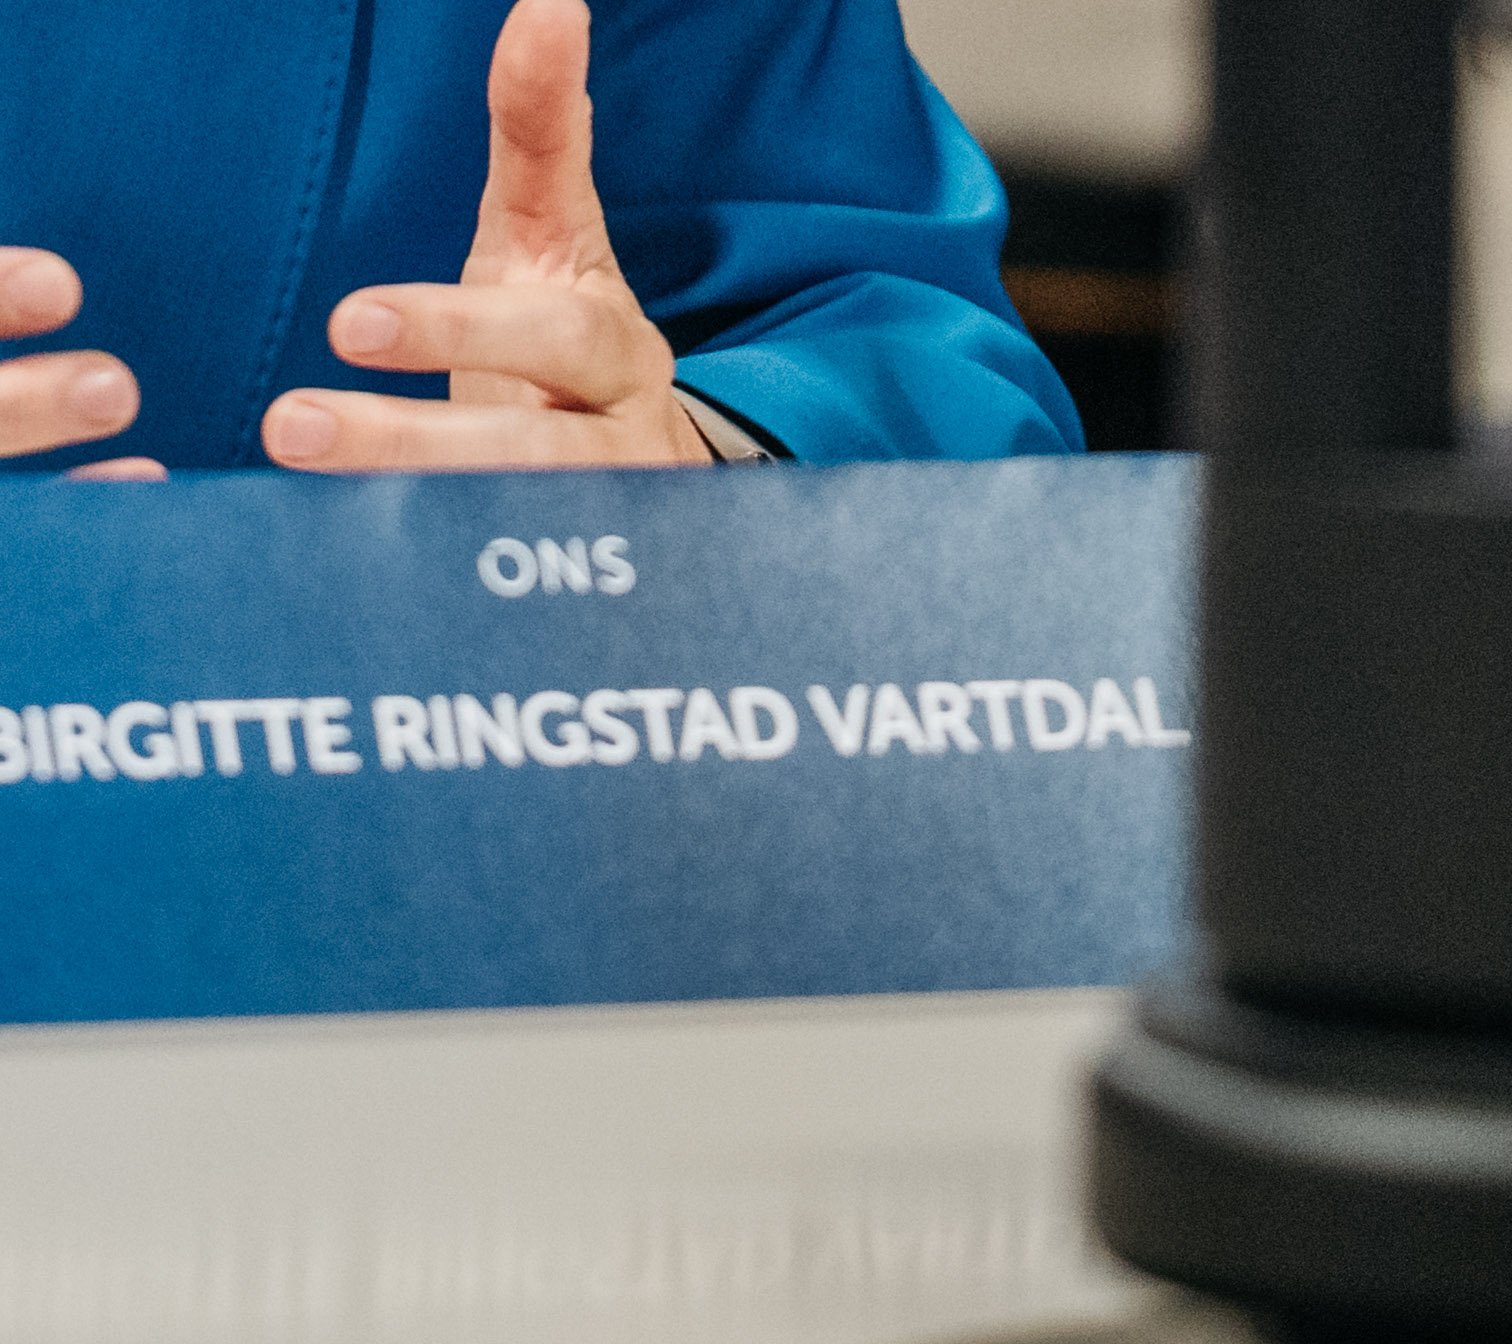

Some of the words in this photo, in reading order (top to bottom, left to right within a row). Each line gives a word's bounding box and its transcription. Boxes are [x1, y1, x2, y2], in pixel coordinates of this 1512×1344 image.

[477, 535, 637, 598] ONS
[373, 686, 799, 772] RINGSTAD
[806, 677, 1192, 757] VARTDAL
